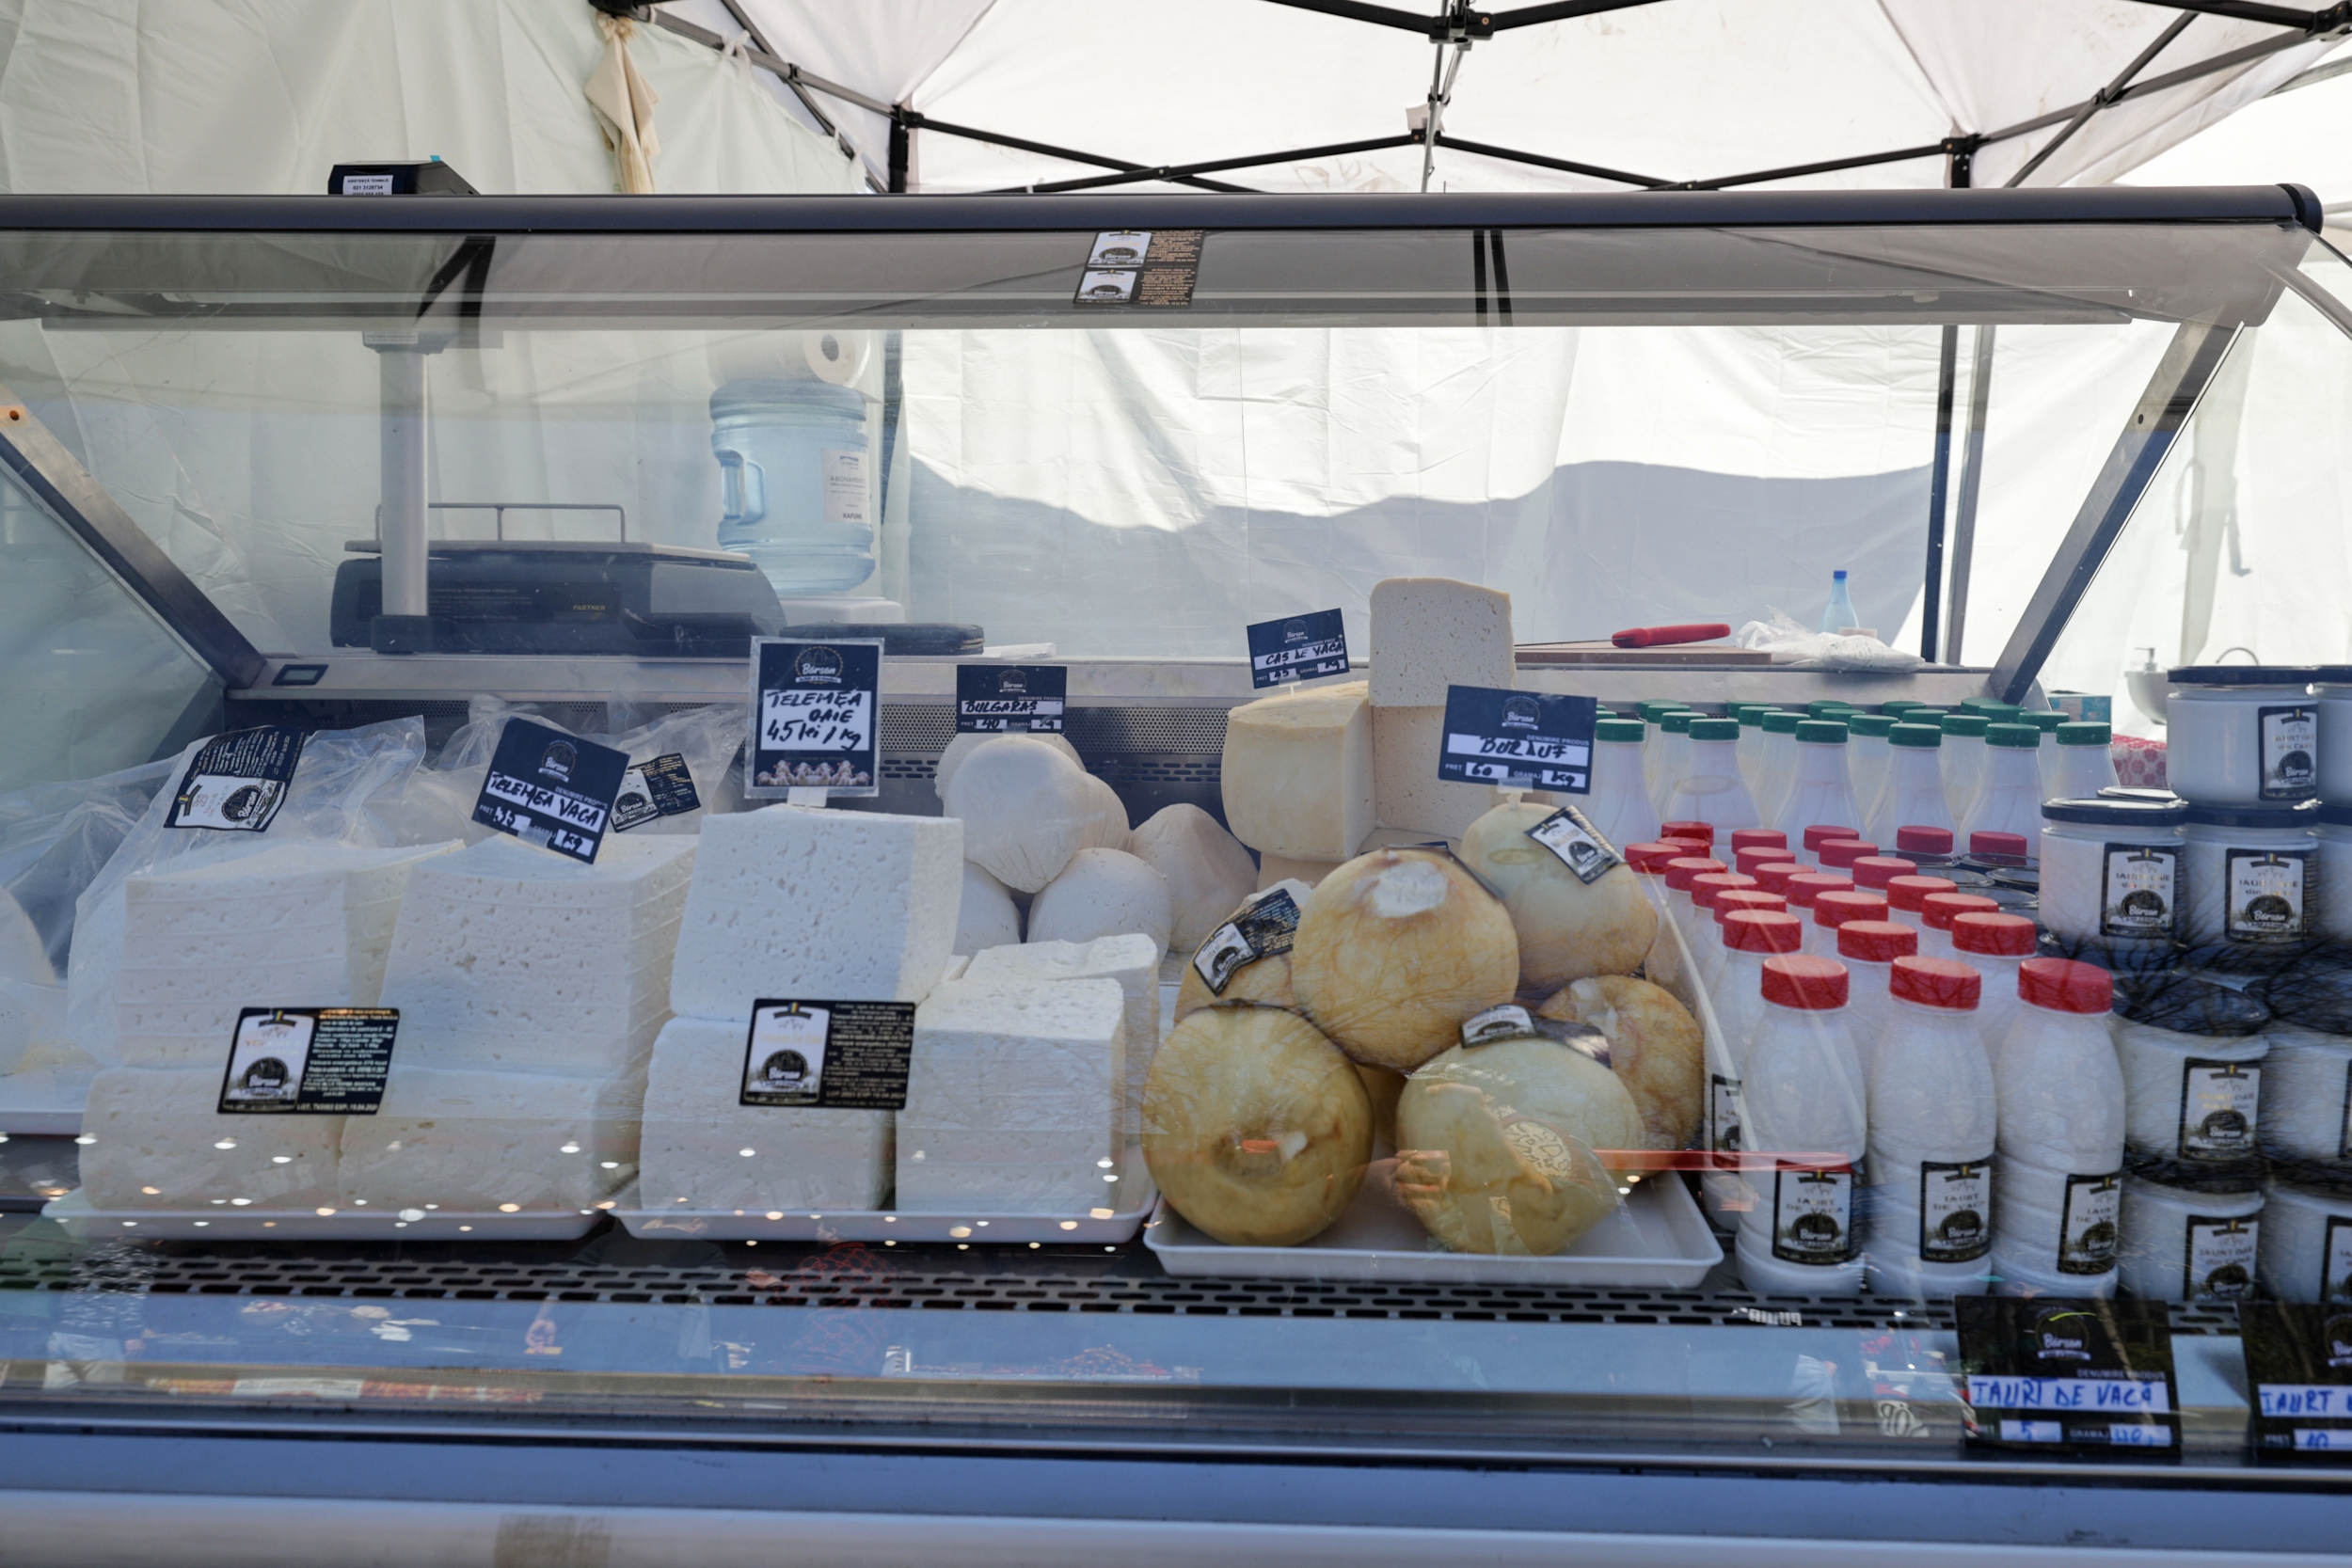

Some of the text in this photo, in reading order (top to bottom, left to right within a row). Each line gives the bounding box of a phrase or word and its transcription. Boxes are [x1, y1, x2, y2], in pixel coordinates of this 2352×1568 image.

[766, 689, 863, 708] TELEMEA
[808, 708, 854, 723] OAIE
[1526, 734, 1589, 746] DENUMIRE PRODUS
[1514, 770, 1542, 780] GRAMAJ
[554, 786, 584, 801] DENUMIRE
[479, 804, 494, 816] PRET
[559, 798, 601, 828] VACA
[2055, 1384, 2086, 1406] DE
[2261, 1388, 2334, 1414] IAURT
